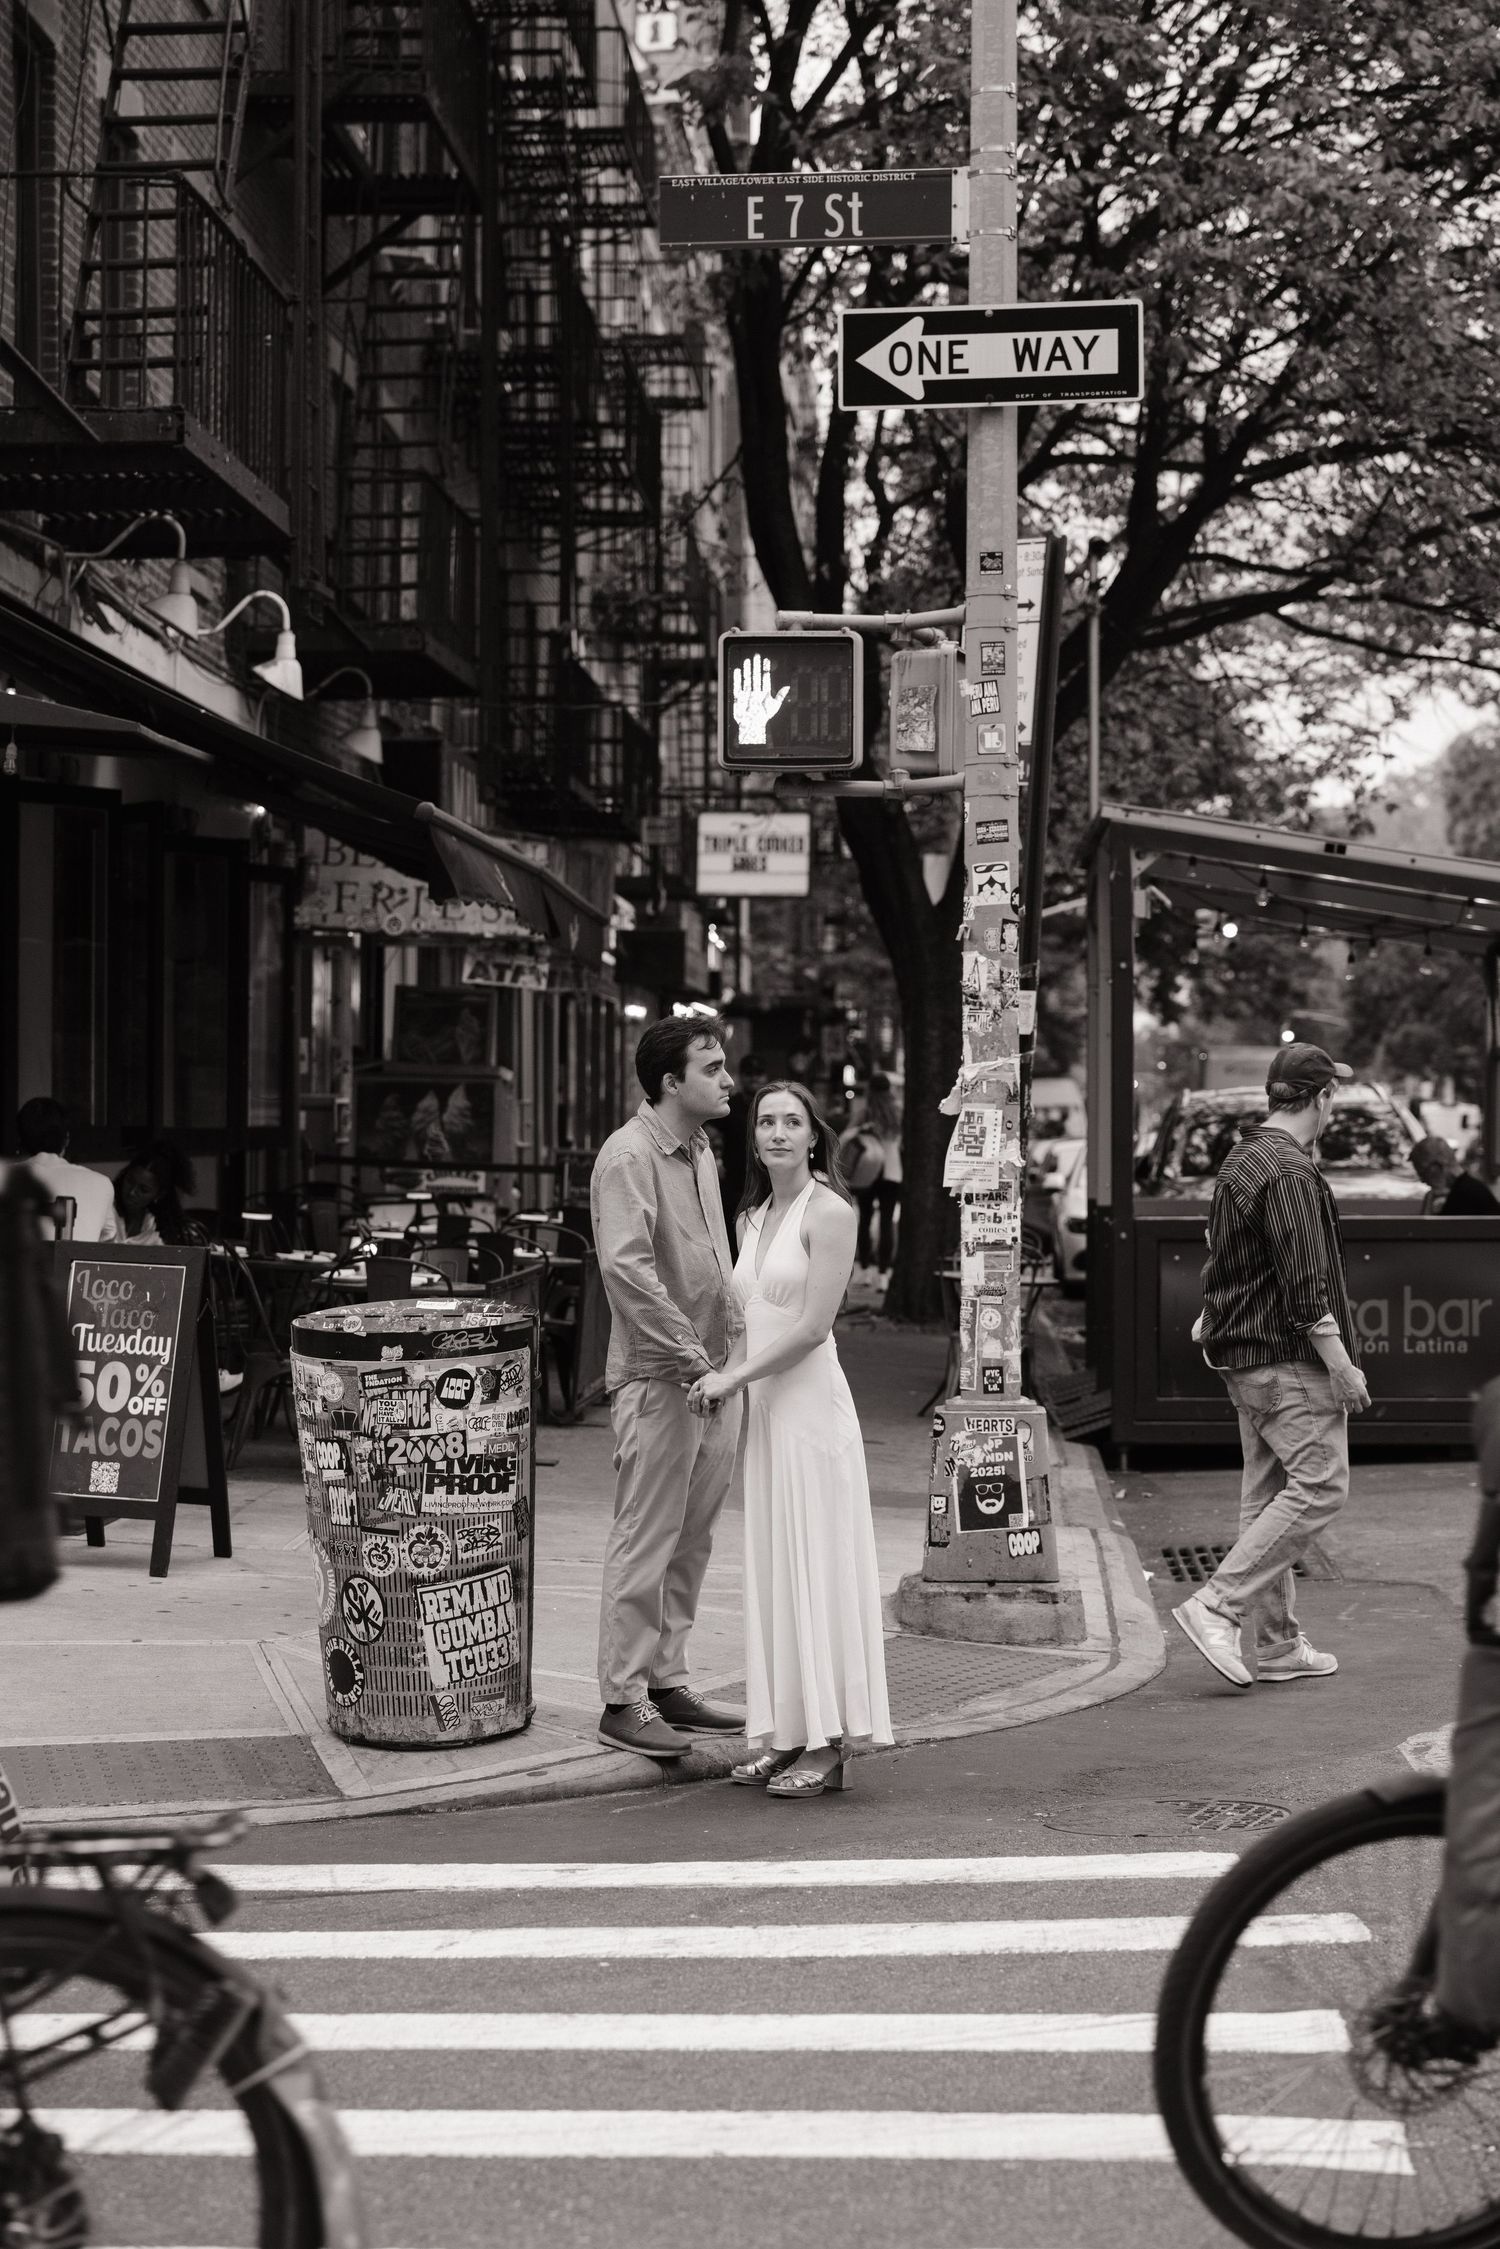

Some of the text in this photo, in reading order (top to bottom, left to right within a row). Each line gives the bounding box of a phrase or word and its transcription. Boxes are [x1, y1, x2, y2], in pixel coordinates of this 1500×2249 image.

[671, 171, 917, 188] EAST VILLAGE/LOWER EAST SIDE HISTORIC DISTRICT
[747, 191, 864, 240] E 7 St
[888, 334, 1100, 377] ONE WAY
[1060, 389, 1128, 397] TRANSPORTATION
[76, 1269, 136, 1302] Loco
[89, 1300, 156, 1331] Taco
[1403, 1285, 1493, 1338] bar
[72, 1322, 172, 1366] Tuesday
[1403, 1337, 1469, 1354] Latina
[364, 1373, 378, 1382] THE
[440, 1377, 471, 1401] LOOP
[127, 1396, 168, 1417] OFF
[56, 1416, 164, 1459] TACOS
[315, 1440, 341, 1469] COOP
[424, 1471, 516, 1496] PROOF
[969, 1465, 1006, 1478] 2025!
[1008, 1530, 1040, 1557] COOP
[421, 1571, 512, 1623] REMAND
[434, 1604, 511, 1652] GUMBA
[325, 1638, 365, 1681] GUERILLA
[445, 1635, 510, 1682] TCU33
